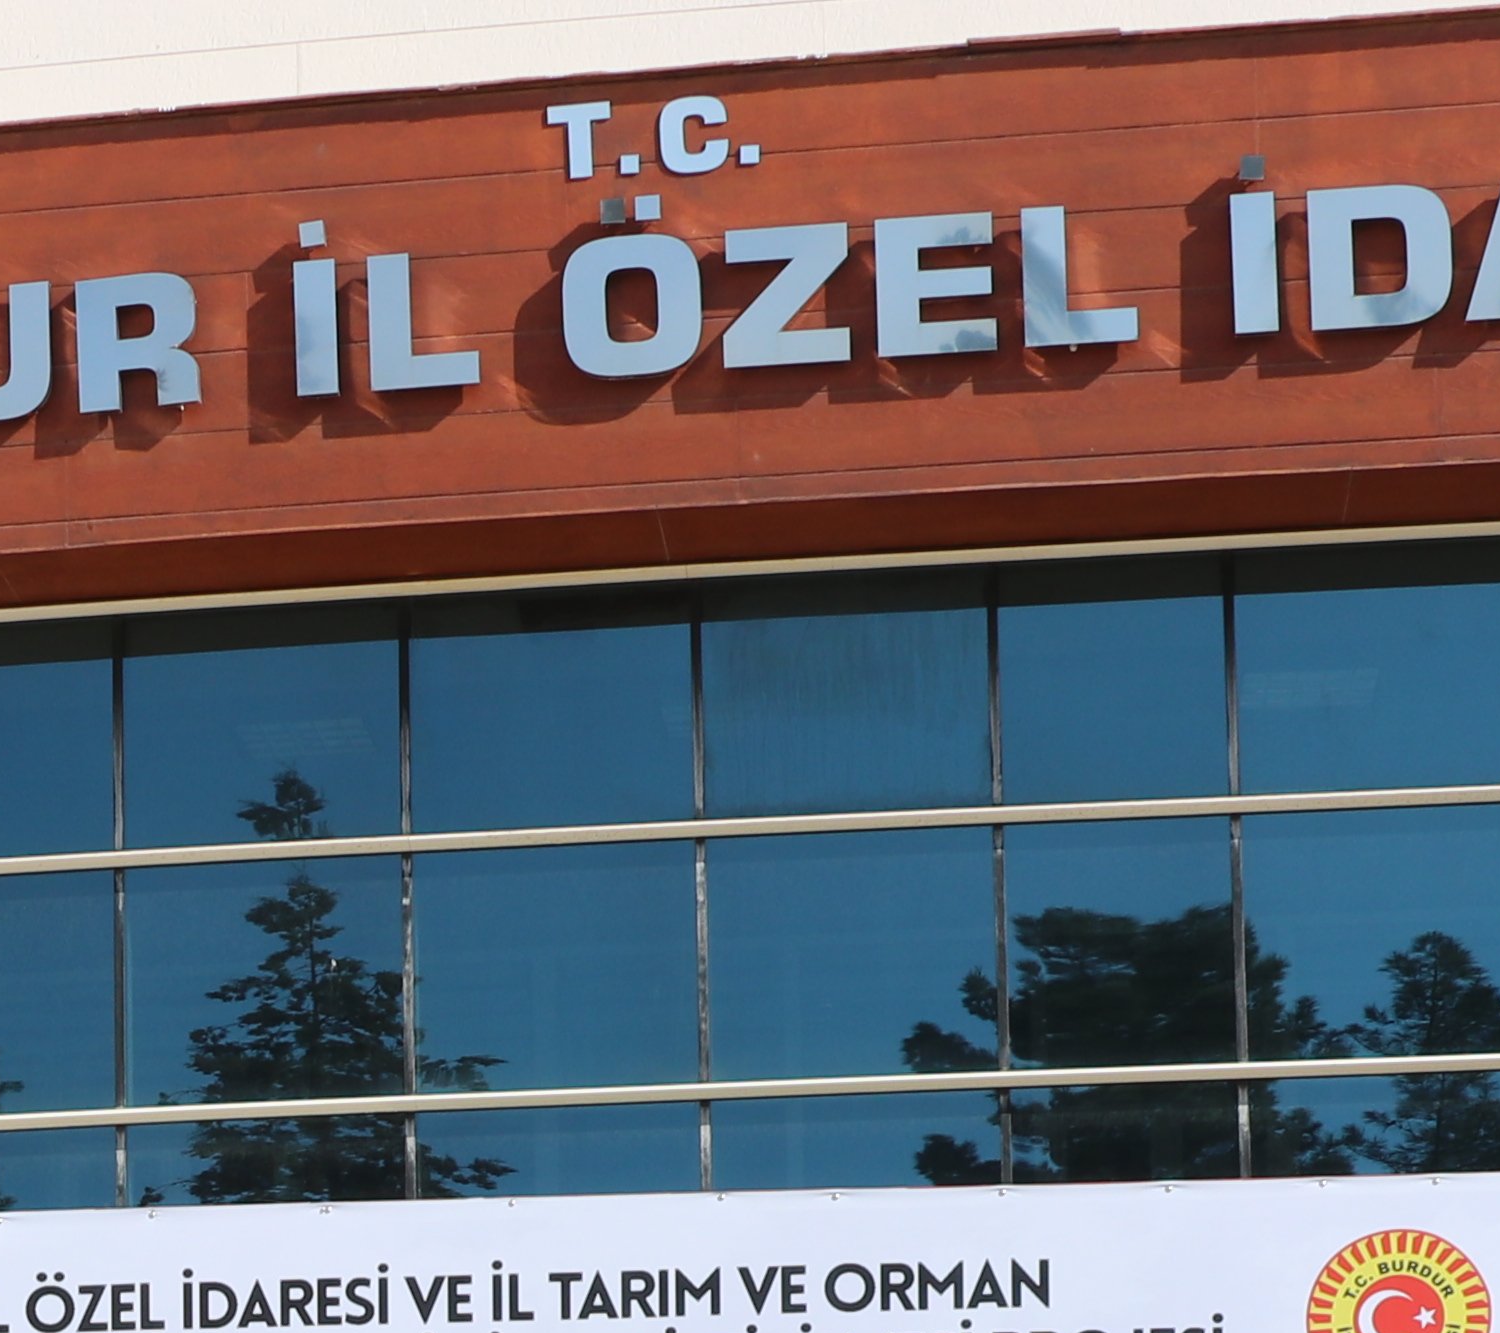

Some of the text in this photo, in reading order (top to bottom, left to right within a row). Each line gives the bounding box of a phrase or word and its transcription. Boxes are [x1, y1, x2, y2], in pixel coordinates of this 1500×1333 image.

[546, 95, 761, 180] T.C.
[293, 220, 480, 396] İL
[562, 194, 1139, 381] ÖZEL
[24, 1270, 166, 1333] ÖZEL
[182, 1263, 389, 1331] İDARESİ
[405, 1272, 472, 1325] VE
[490, 1260, 535, 1323] İL
[547, 1266, 721, 1320] TARIM
[737, 1264, 806, 1316] VE
[822, 1257, 1052, 1311] ORMAN
[1342, 1259, 1455, 1301] T.C. BURDUR
